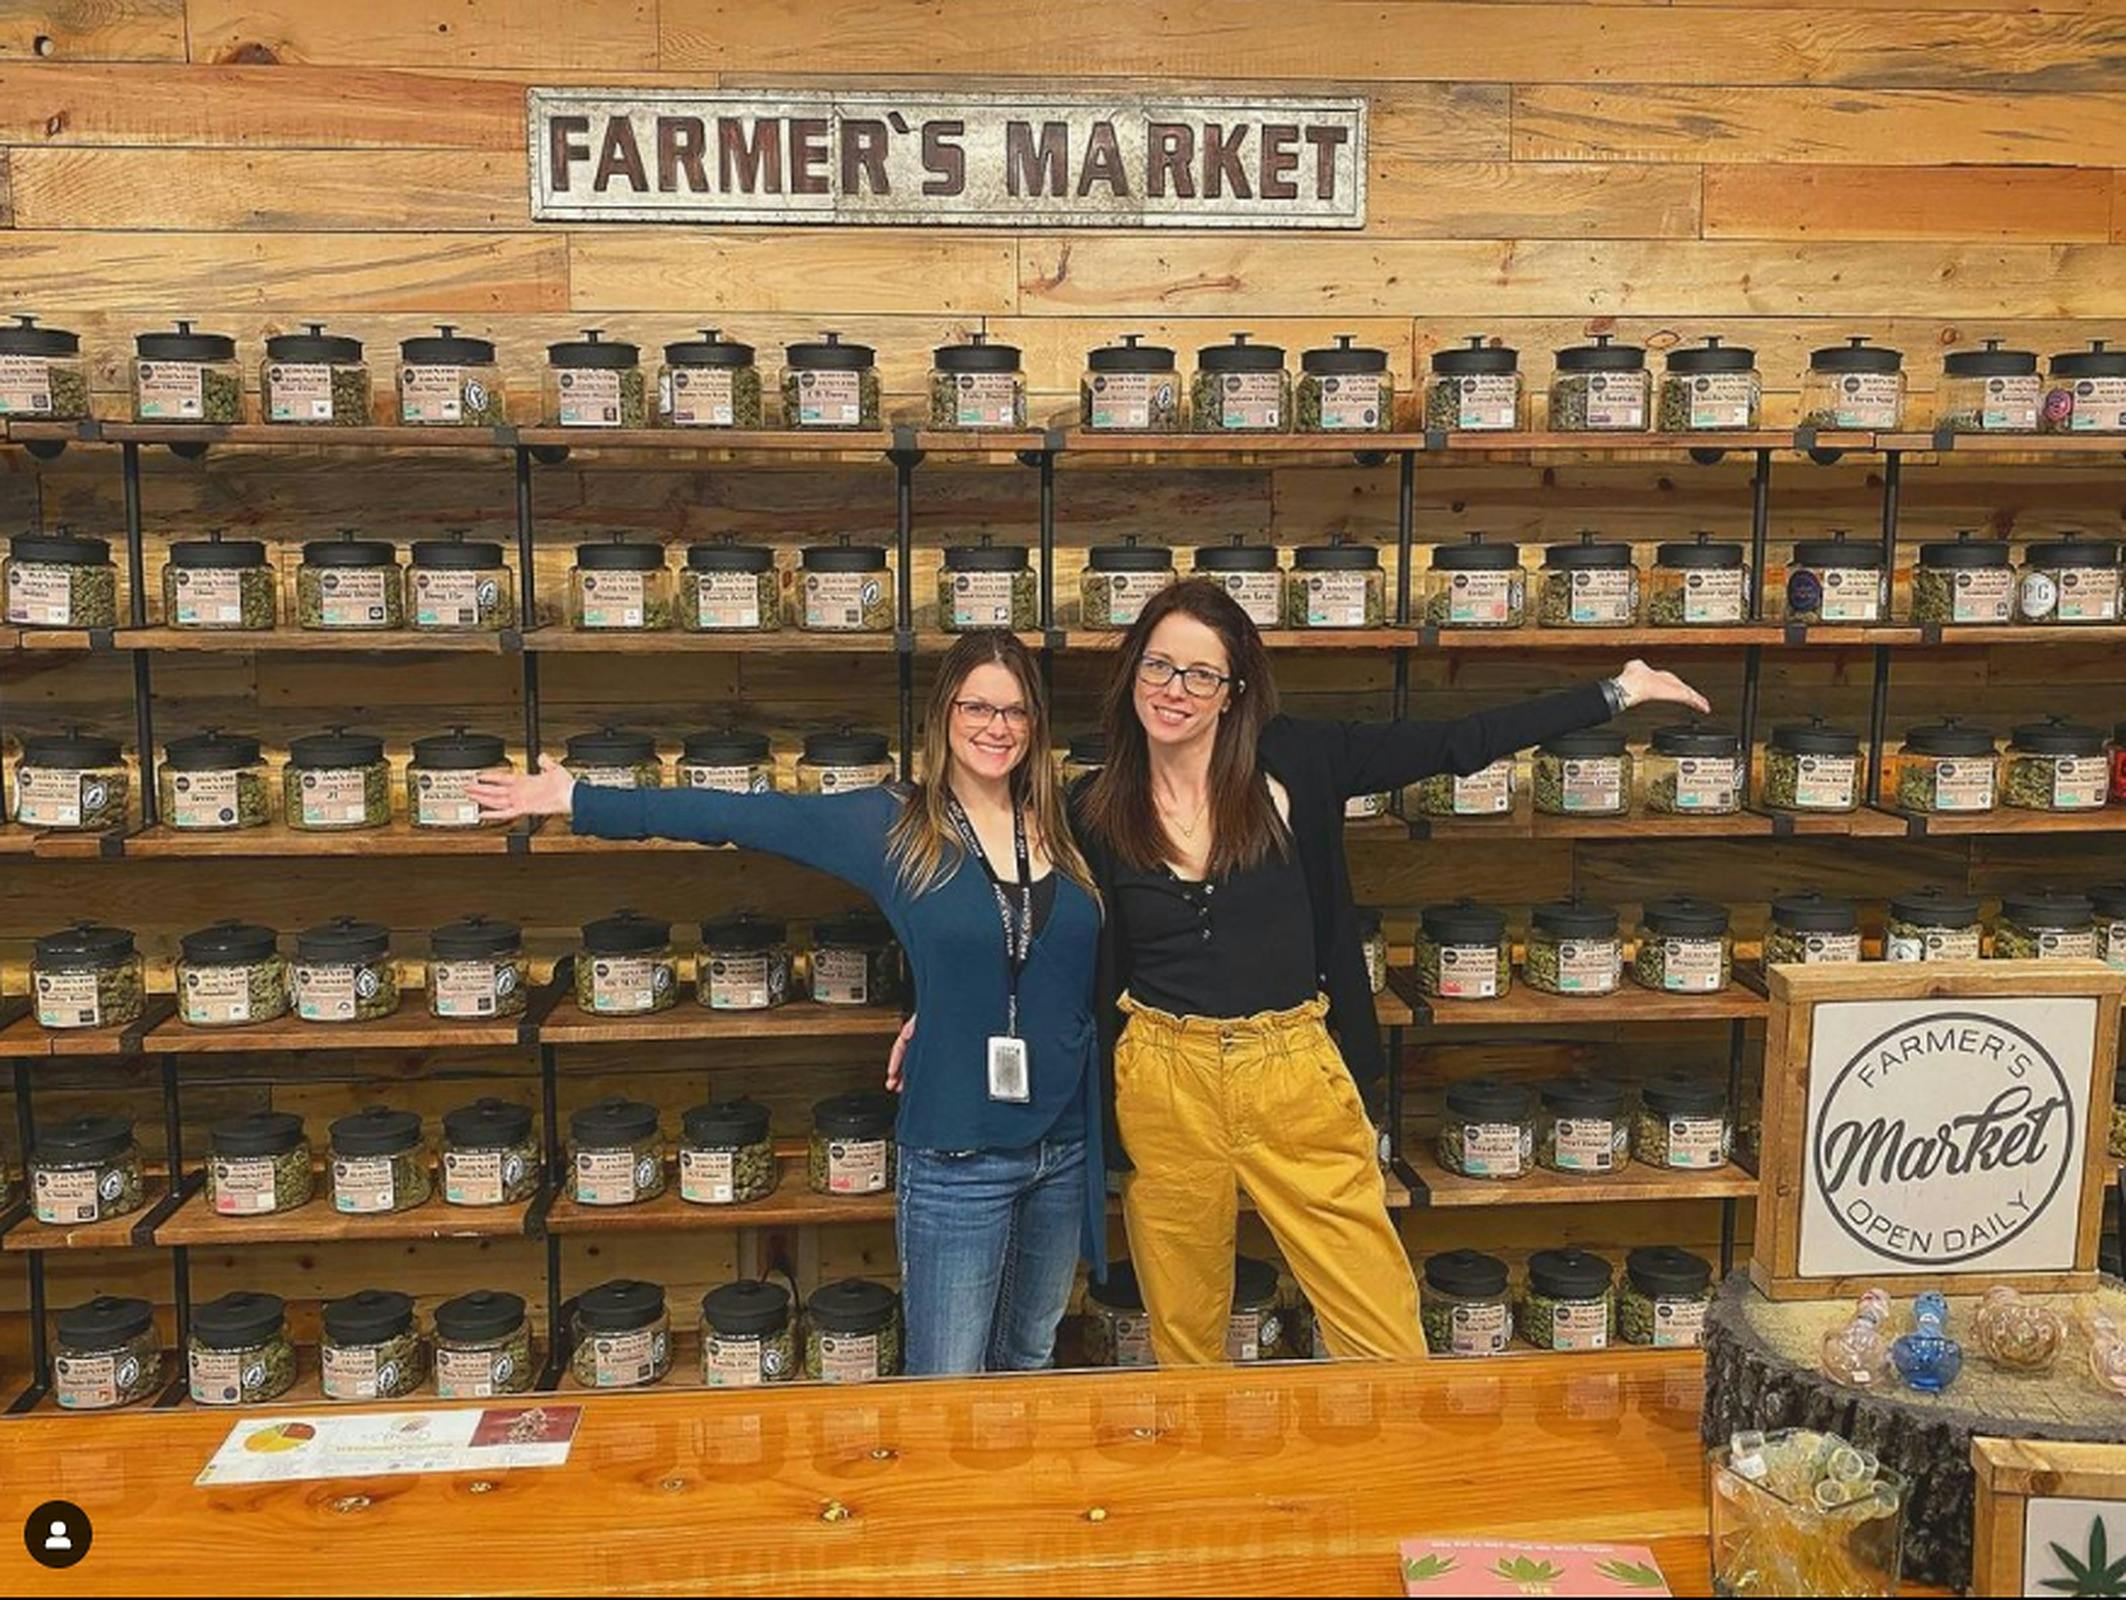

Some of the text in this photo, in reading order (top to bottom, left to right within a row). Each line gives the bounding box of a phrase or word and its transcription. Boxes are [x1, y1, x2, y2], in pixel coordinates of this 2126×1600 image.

[547, 110, 1349, 201] FARMER'S MARKET
[1858, 1028, 2034, 1089] FARMER'S
[1824, 1086, 2068, 1194] Market
[1846, 1189, 2032, 1254] OPEN DAILY
